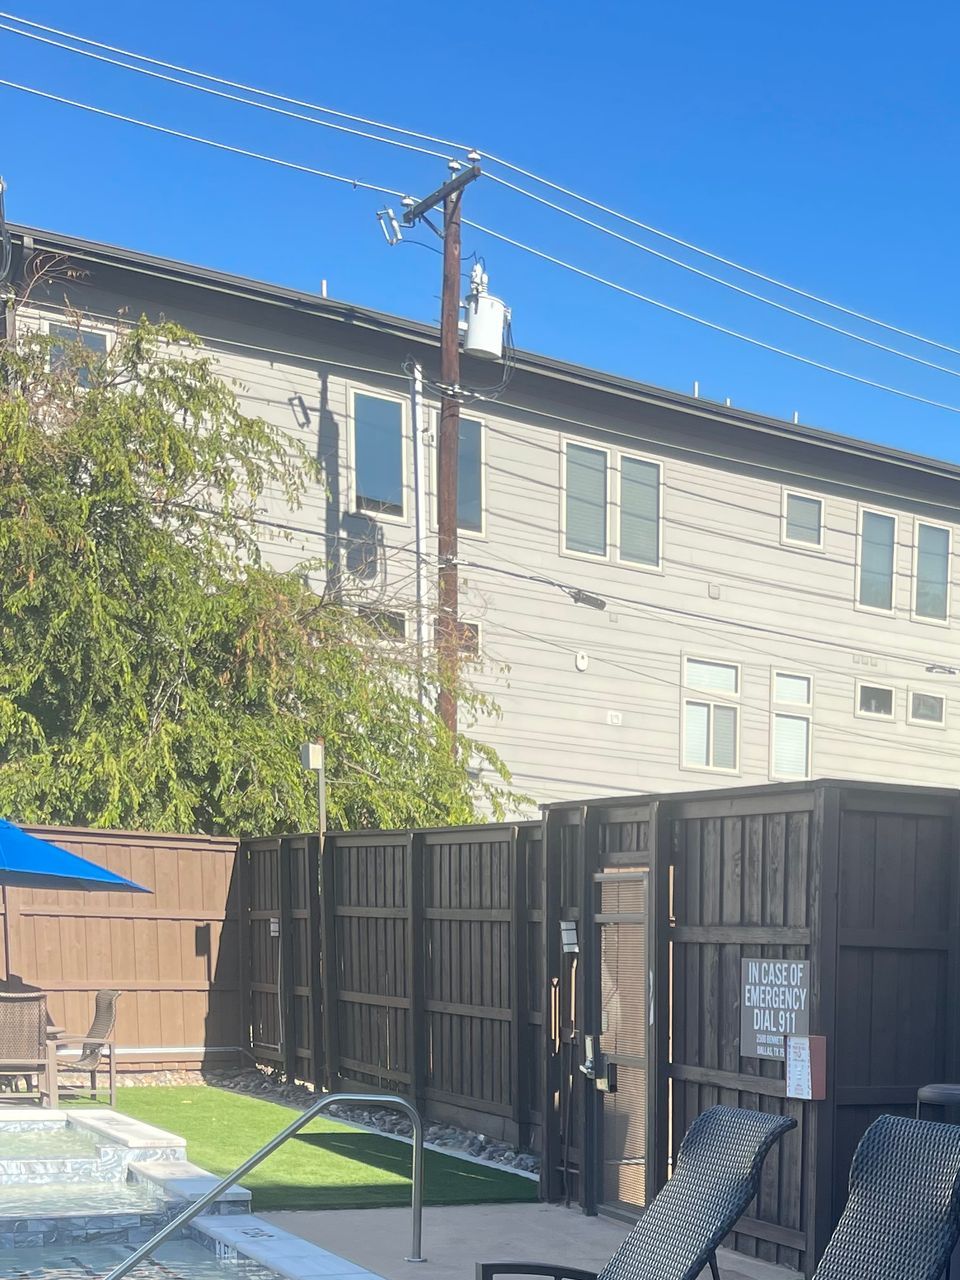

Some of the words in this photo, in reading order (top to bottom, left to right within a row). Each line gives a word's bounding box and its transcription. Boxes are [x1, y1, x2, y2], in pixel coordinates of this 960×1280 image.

[749, 962, 759, 983] IN
[761, 962, 788, 985] CASE
[790, 963, 803, 986] OF
[745, 985, 807, 1010] EMERGENCY
[754, 1009, 776, 1031] DIAL
[779, 1010, 795, 1033] 911
